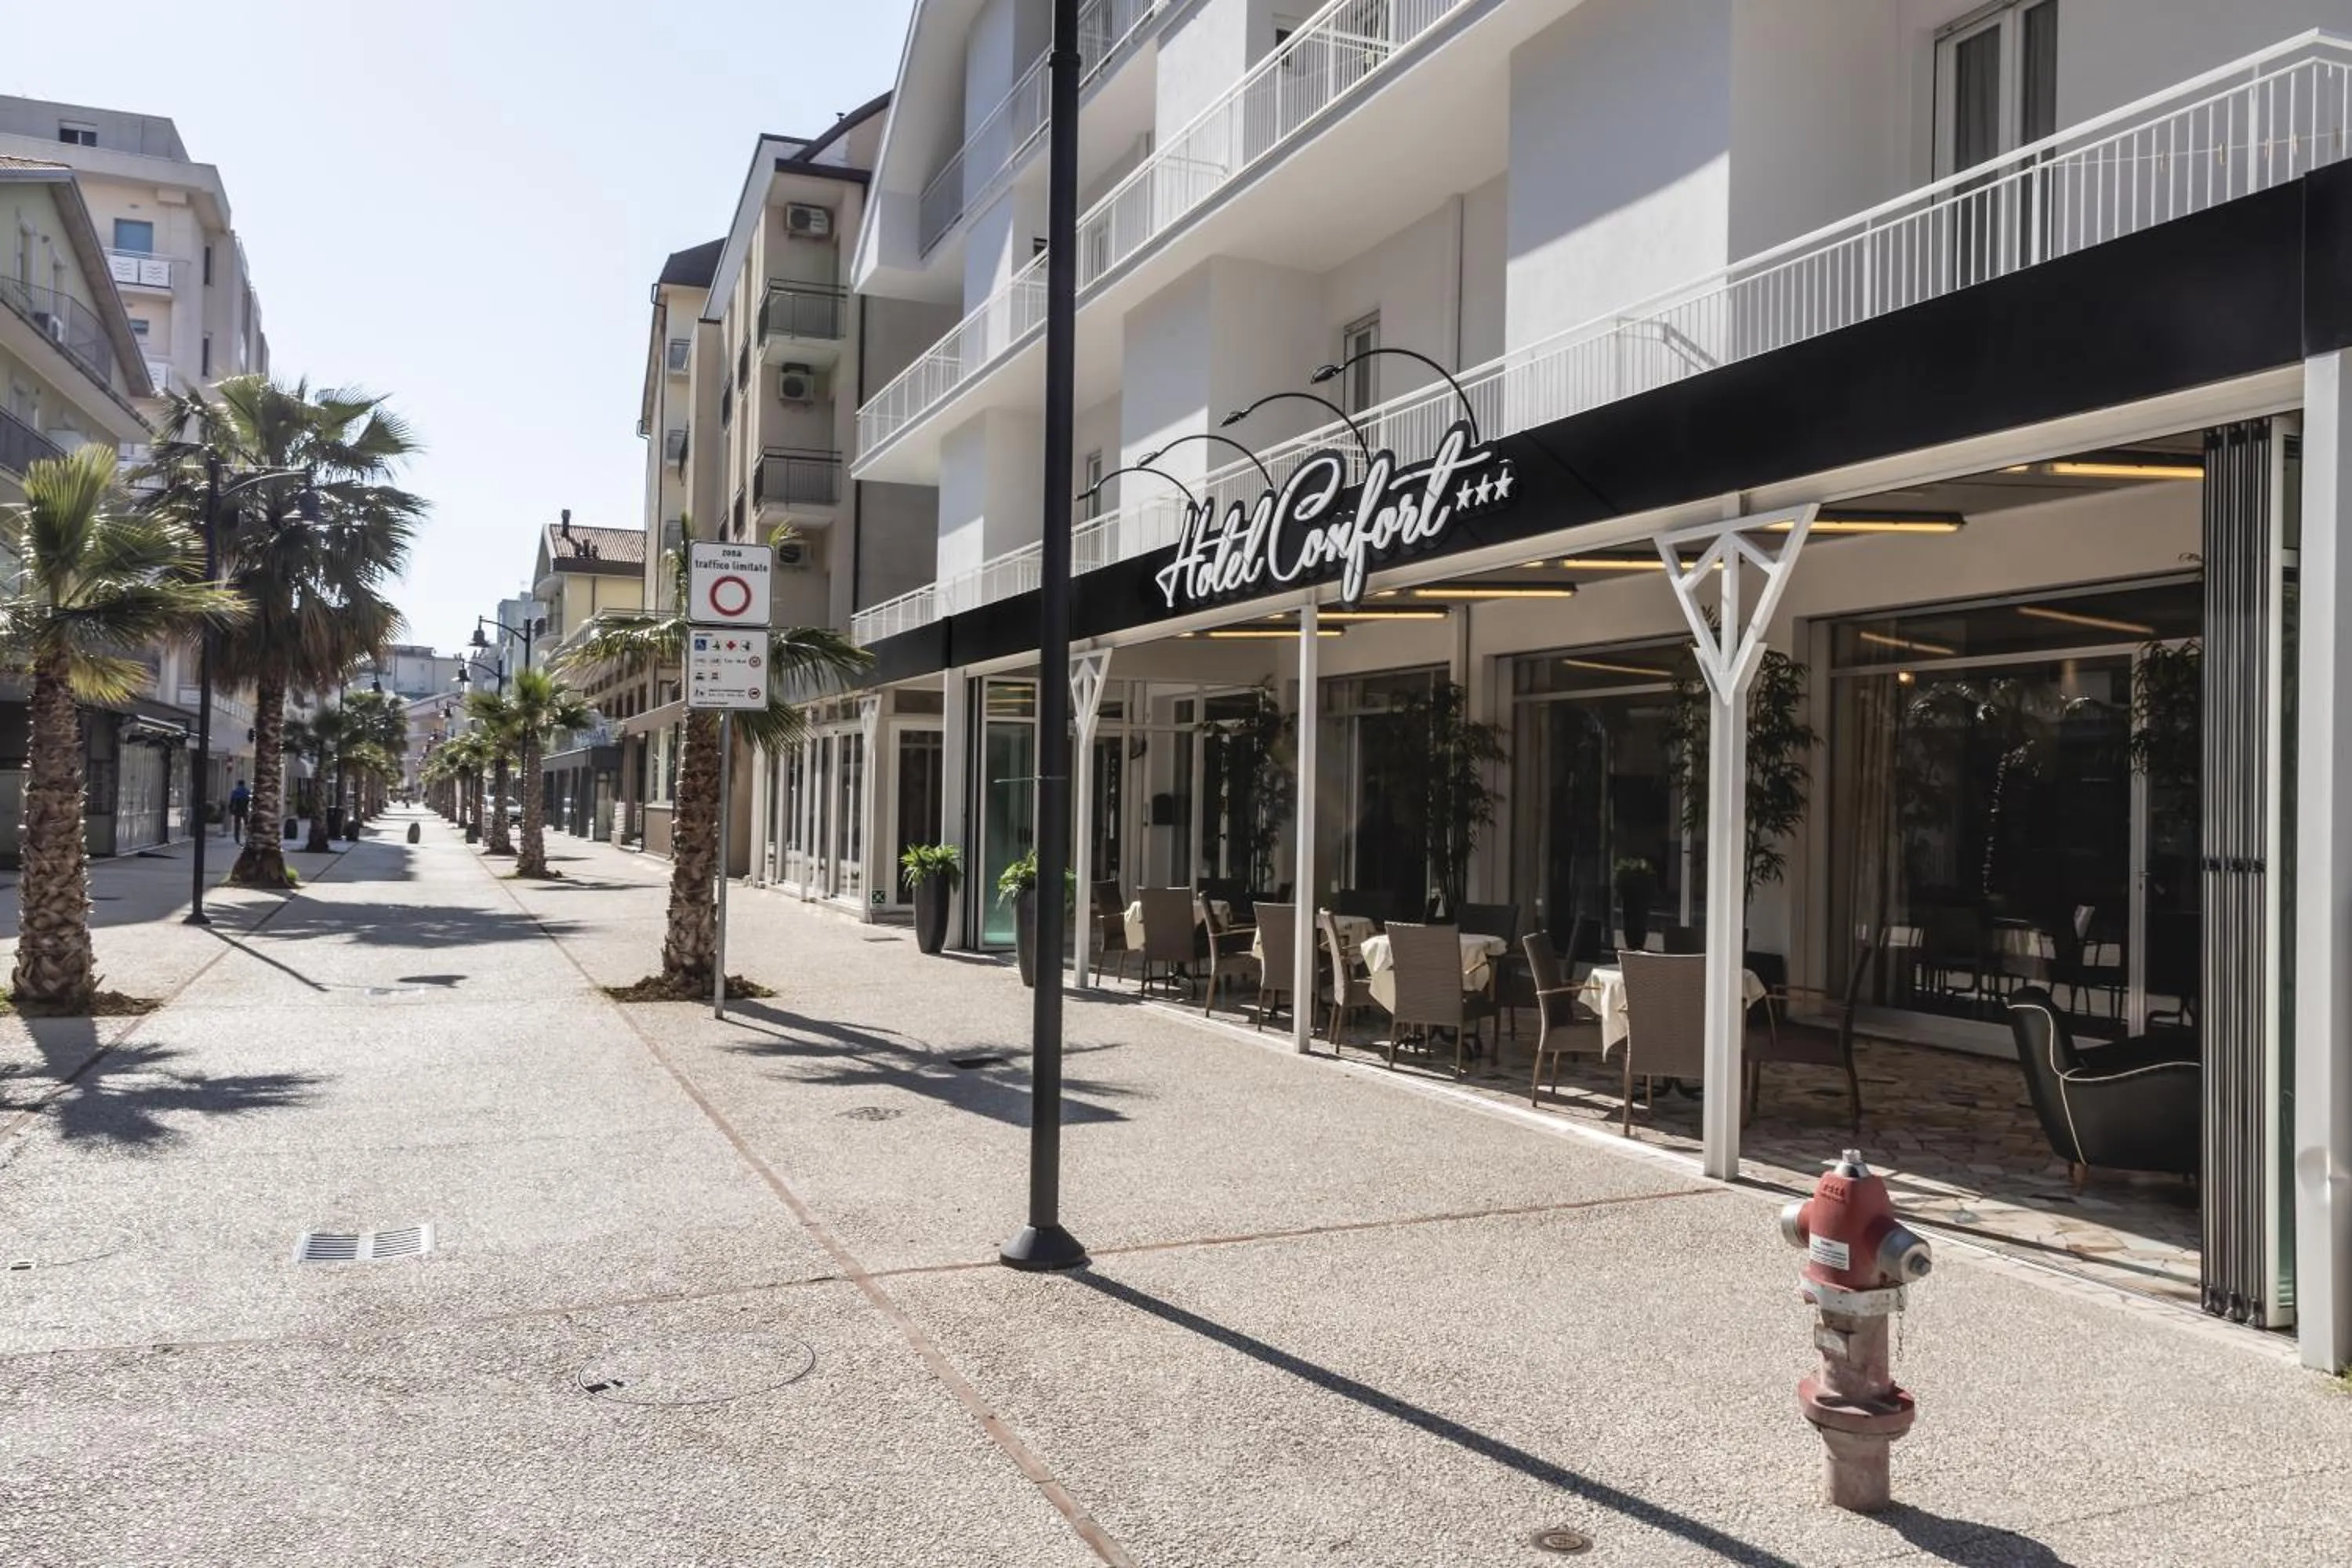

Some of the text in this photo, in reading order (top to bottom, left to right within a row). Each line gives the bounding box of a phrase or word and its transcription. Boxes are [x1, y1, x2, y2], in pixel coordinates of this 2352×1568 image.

[1155, 430, 1492, 608] Hotel Confort
[721, 549, 742, 558] zona
[695, 559, 730, 570] traffico
